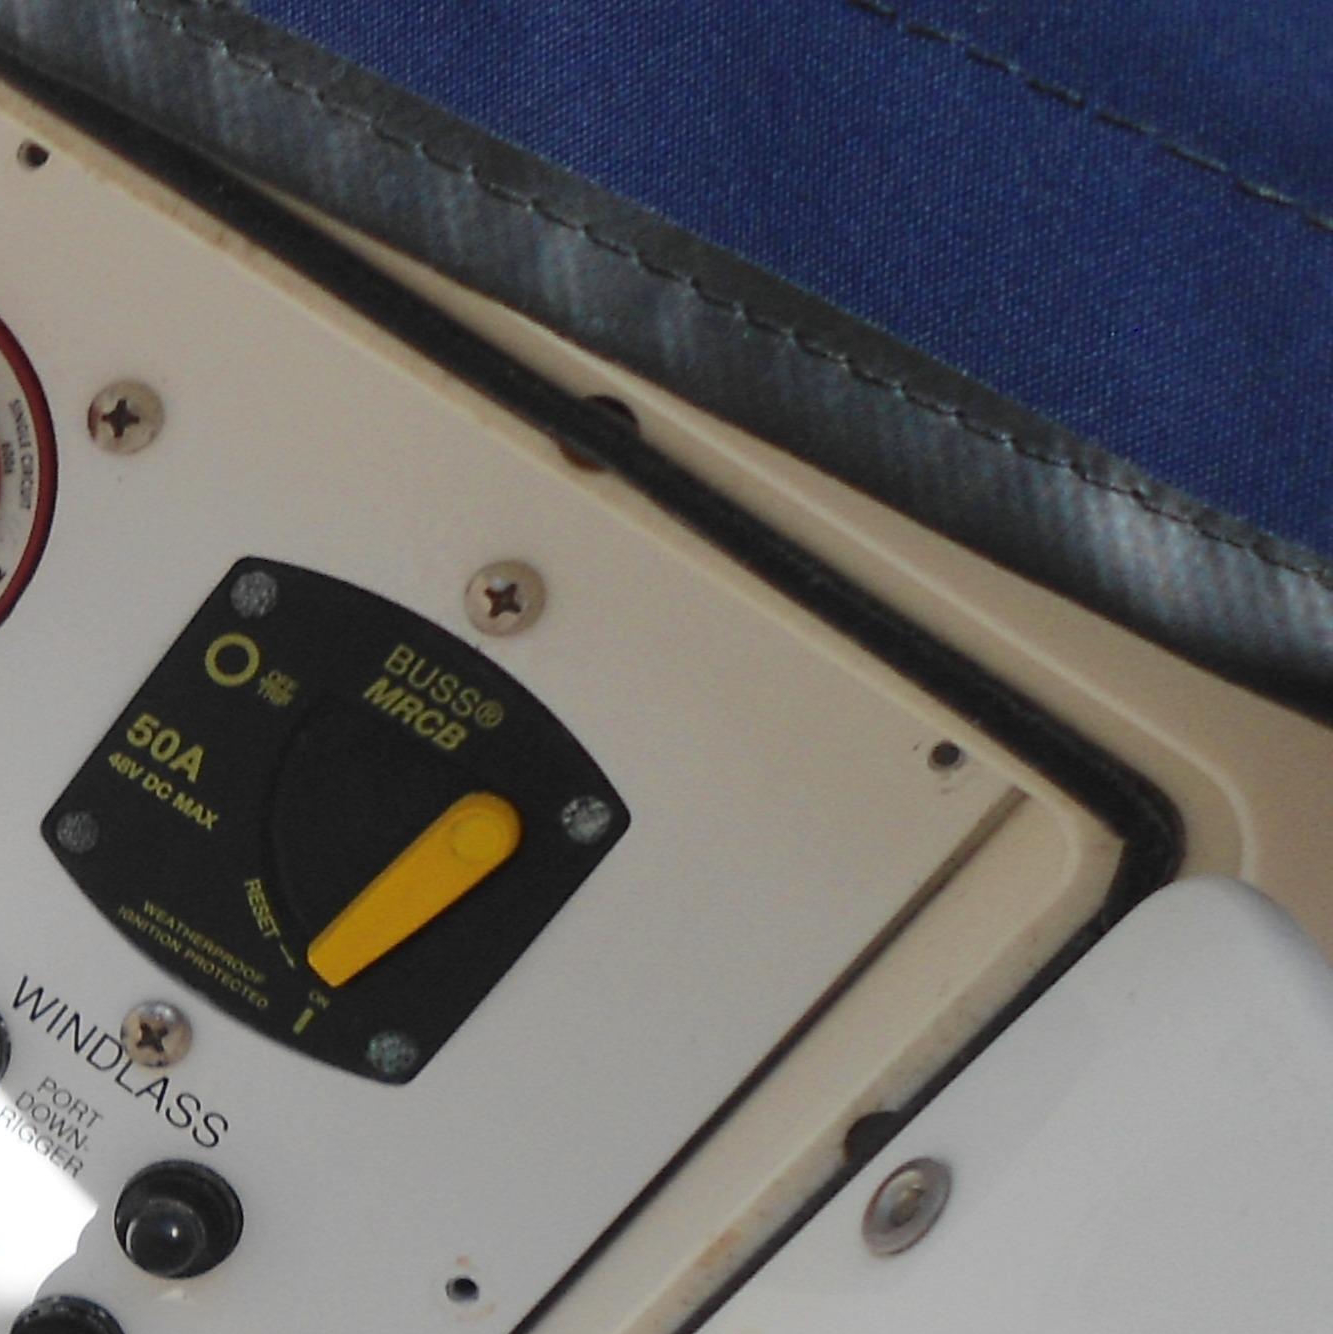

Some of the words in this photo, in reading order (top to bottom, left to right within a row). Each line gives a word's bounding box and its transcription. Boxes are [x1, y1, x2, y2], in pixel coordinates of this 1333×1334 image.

[126, 713, 204, 784] 50A
[363, 677, 469, 751] MRCB
[142, 772, 173, 801] DC
[172, 792, 219, 831] MAX
[143, 899, 266, 984] WEATHERPROOF
[244, 878, 281, 940] RESET
[118, 905, 182, 953] IGNITION
[183, 949, 269, 1009] PROTECTED
[13, 975, 230, 1150] WINDLASS
[15, 1090, 89, 1151] DOWN-
[37, 1076, 103, 1129] PORT
